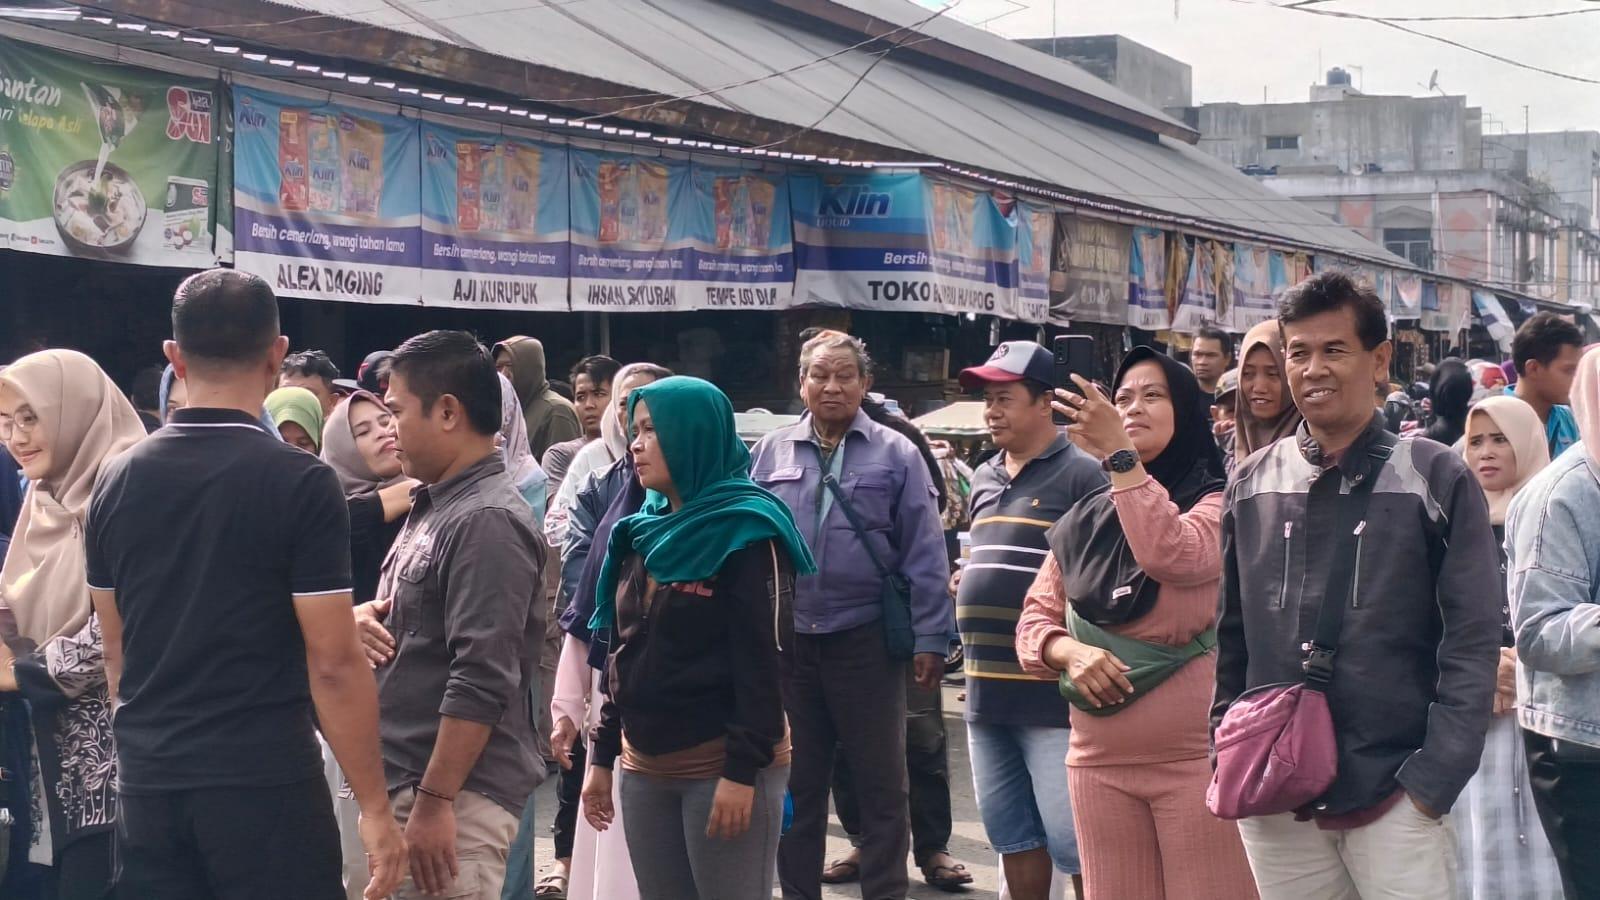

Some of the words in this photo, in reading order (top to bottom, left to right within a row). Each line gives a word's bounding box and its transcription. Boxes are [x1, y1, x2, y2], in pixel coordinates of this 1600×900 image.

[817, 185, 892, 217] Klin
[252, 223, 278, 240] Bersih
[333, 233, 358, 252] wangi
[359, 235, 385, 251] tahan
[386, 237, 405, 253] lama
[433, 243, 459, 258] Bersih
[883, 250, 929, 265] Bersih
[276, 263, 321, 291] ALEX
[324, 267, 383, 296] DAGING
[453, 278, 477, 302] AJI
[480, 279, 538, 305] KURUPUK
[868, 280, 931, 301] TOKO
[587, 284, 626, 306] IHSAN
